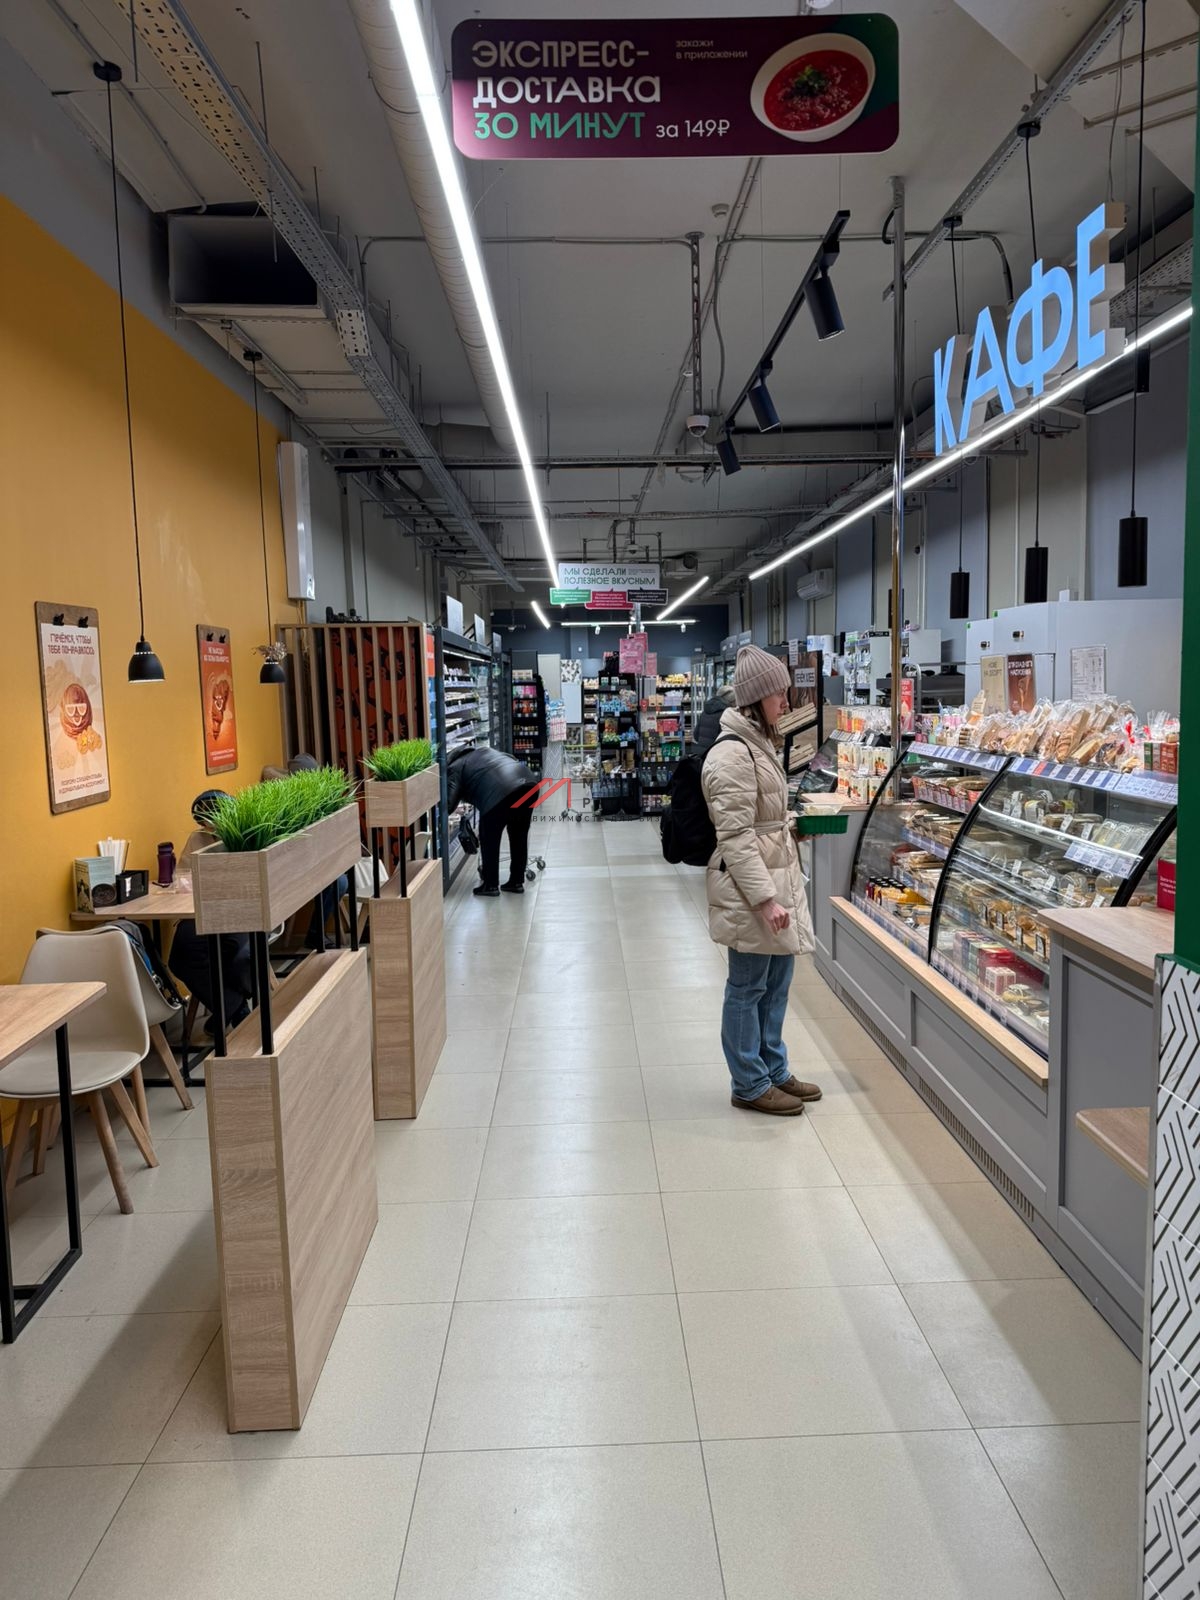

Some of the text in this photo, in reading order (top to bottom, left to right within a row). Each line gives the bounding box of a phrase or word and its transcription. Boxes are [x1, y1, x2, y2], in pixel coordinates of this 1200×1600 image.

[675, 40, 714, 48] закажи
[472, 40, 649, 68] ЭКСПРЕСС-
[684, 51, 748, 61] приложении
[474, 112, 730, 139] 30 МИНУТ за 149₽
[934, 203, 1105, 456] КАФЕ
[564, 577, 656, 585] ПОЛЕЗНОЕ ВКУСНЫМ
